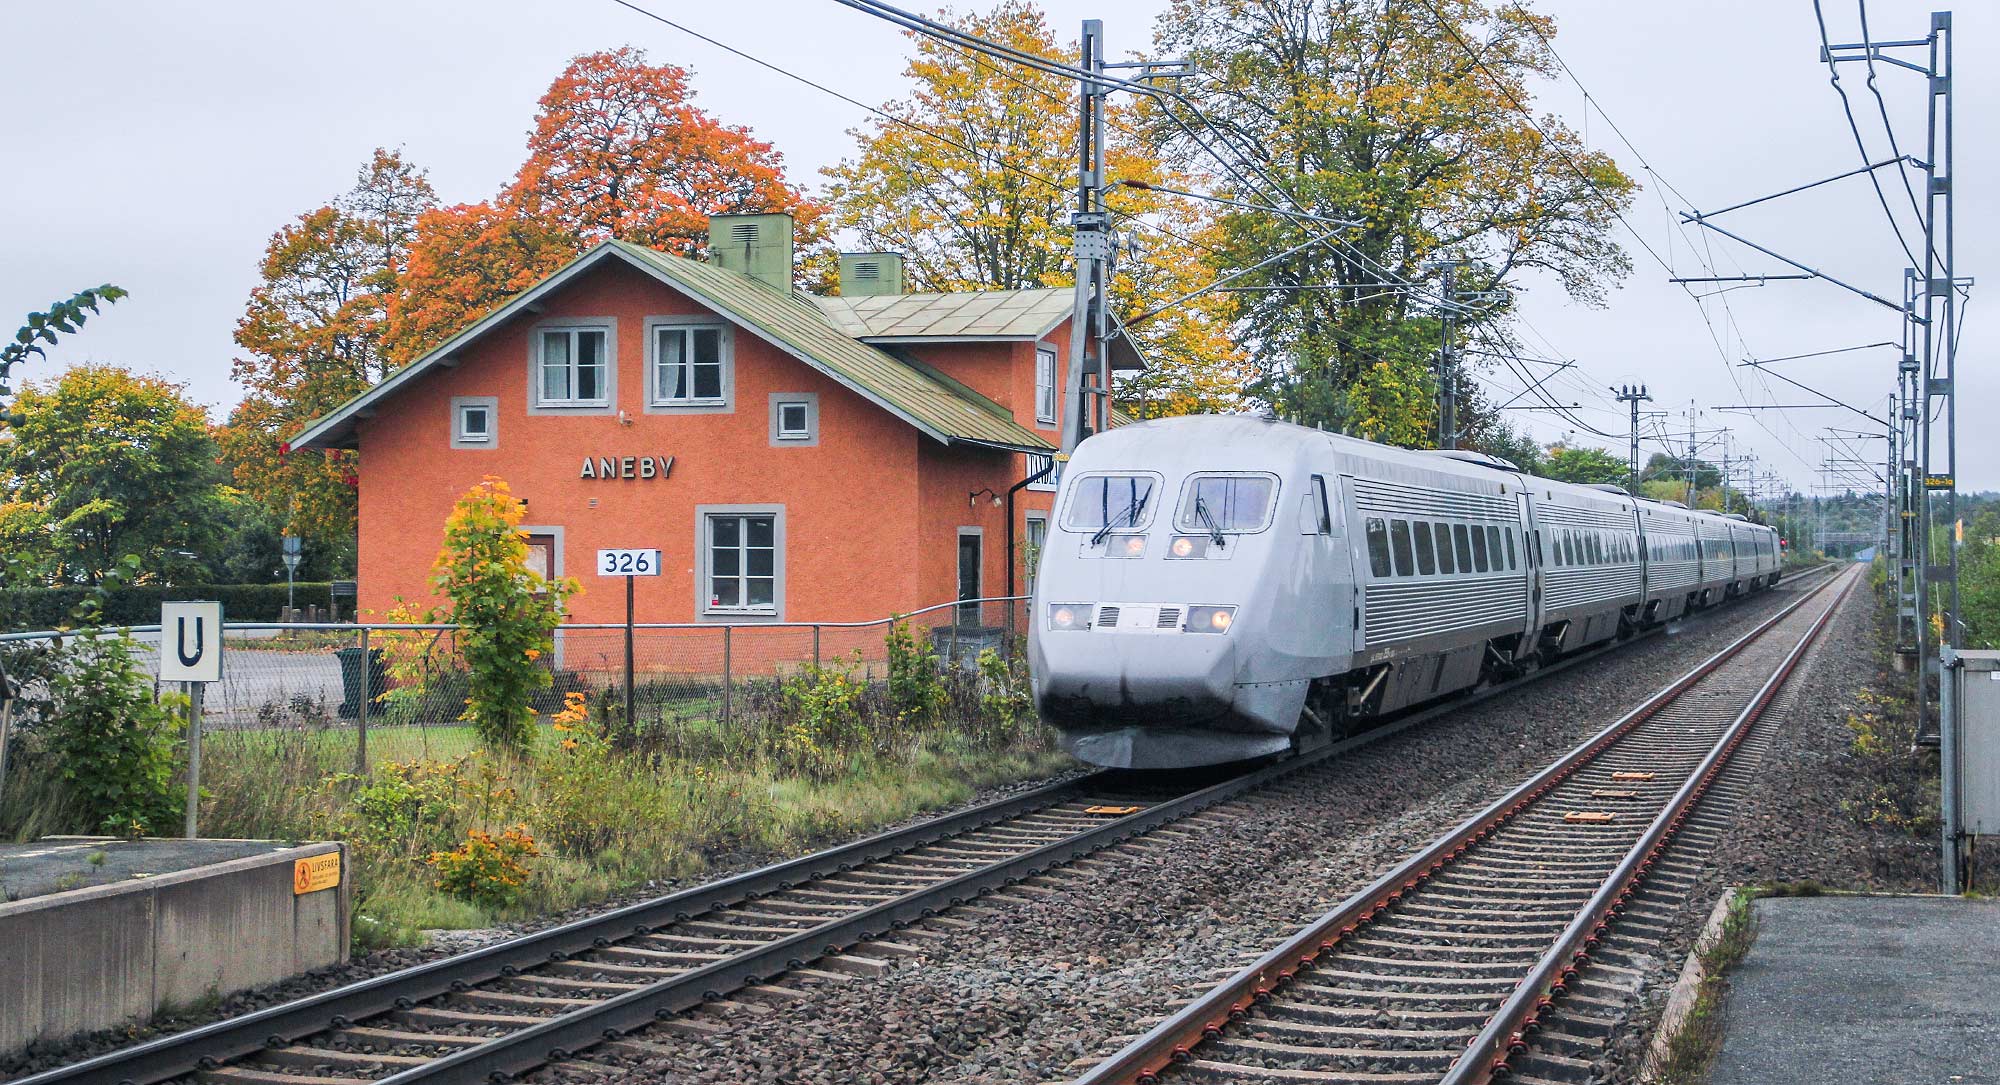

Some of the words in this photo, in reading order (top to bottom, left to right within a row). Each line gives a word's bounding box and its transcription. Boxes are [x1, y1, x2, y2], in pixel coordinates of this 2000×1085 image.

[580, 456, 675, 479] ANEBY
[605, 553, 649, 572] 326
[178, 617, 203, 667] U
[311, 858, 338, 873] LIVSFARA
